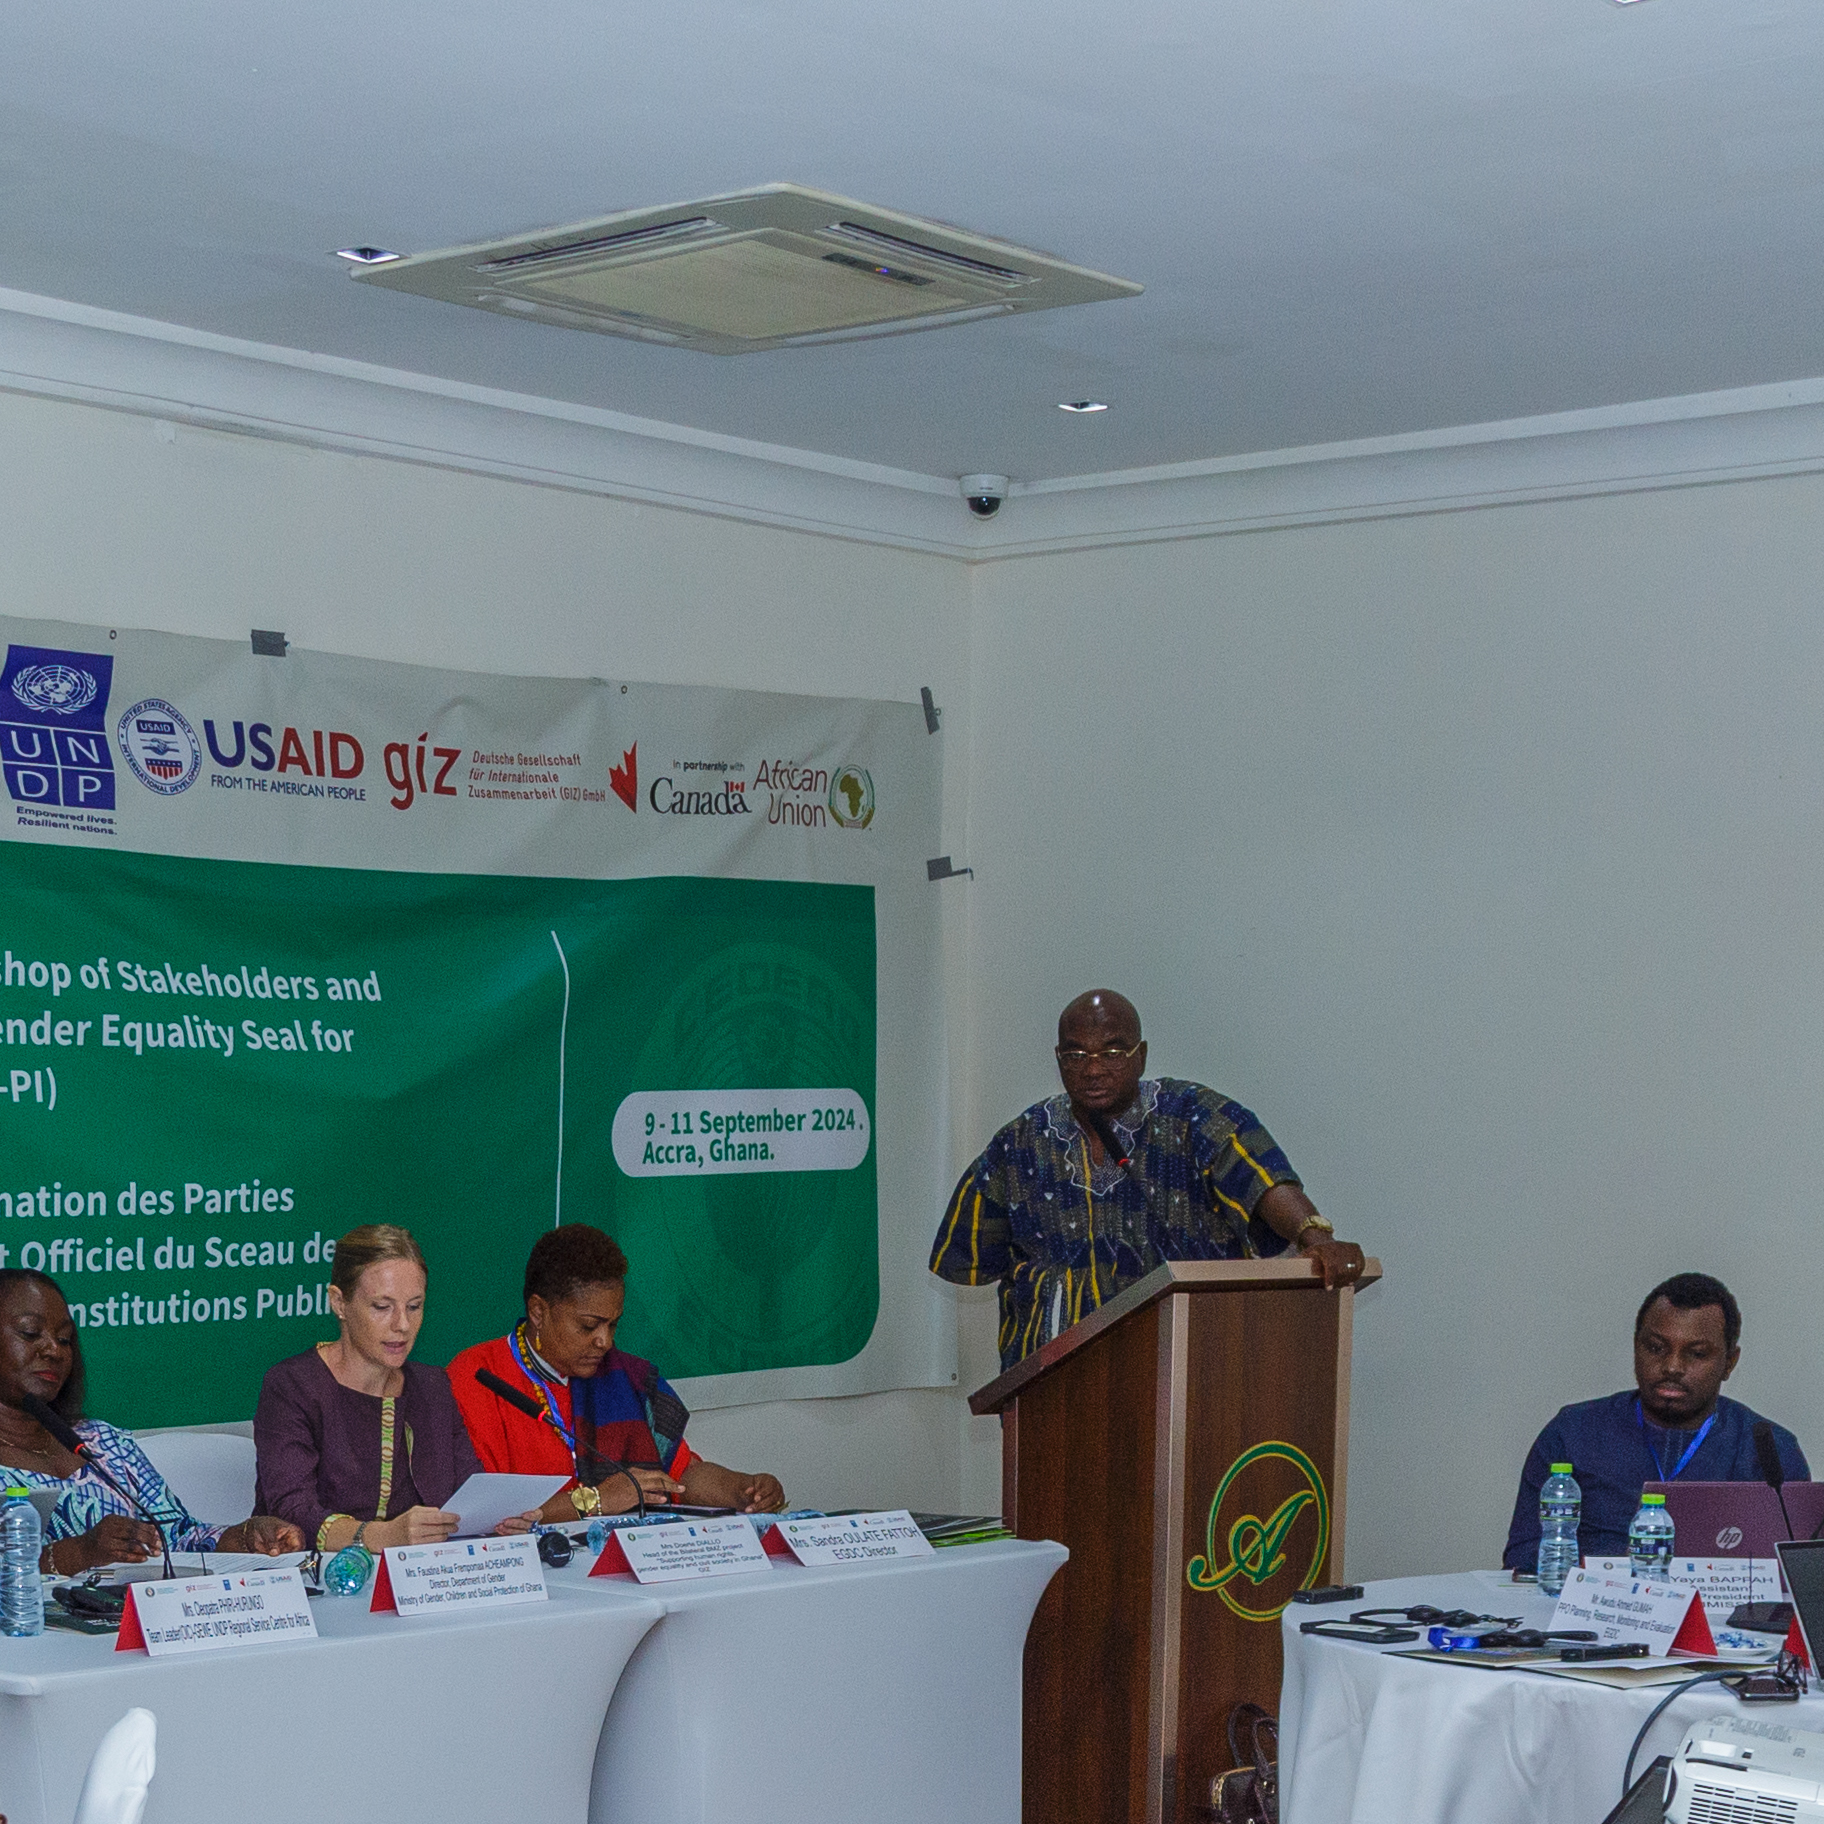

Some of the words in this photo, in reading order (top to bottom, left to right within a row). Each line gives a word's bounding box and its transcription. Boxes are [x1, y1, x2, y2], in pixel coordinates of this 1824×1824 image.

[140, 723, 171, 732] USAID
[203, 719, 365, 780] USAID
[473, 750, 514, 765] Deutsche
[517, 753, 581, 766] Gesellschaft
[384, 732, 462, 810] giz
[469, 768, 484, 780] für
[488, 770, 559, 783] Internationale
[683, 760, 728, 773] partnership
[753, 760, 827, 793] African
[211, 775, 243, 789] FROM
[245, 778, 268, 792] THE
[270, 780, 324, 797] AMERICAN
[328, 786, 366, 801] PEOPLE
[468, 785, 557, 800] Zusammenarbeit
[650, 778, 752, 815] Canada
[17, 806, 84, 822] Empowered
[87, 815, 117, 825] lives.
[768, 793, 826, 827] Union
[18, 817, 70, 830] Resilient
[72, 823, 117, 835] nations.
[80, 956, 113, 991] of
[120, 960, 319, 1003] Stakeholders
[326, 970, 383, 1004] and
[101, 1012, 235, 1059] Equality
[241, 1018, 307, 1054] Seal
[312, 1020, 356, 1054] for
[645, 1112, 655, 1136] 9
[671, 1112, 693, 1135] 11
[699, 1108, 806, 1139] September
[642, 1141, 704, 1168] Accra,
[709, 1137, 775, 1162] Ghana.
[116, 1180, 176, 1219] des
[183, 1178, 295, 1216] Parties
[20, 1237, 145, 1273] Officiel
[154, 1236, 194, 1270] du
[204, 1236, 294, 1268] Sceau
[303, 1231, 336, 1263] de
[811, 1534, 844, 1547] Sandra
[843, 1530, 882, 1544] OULATE
[882, 1527, 921, 1539] FATTOH
[833, 1548, 860, 1560] EGDC
